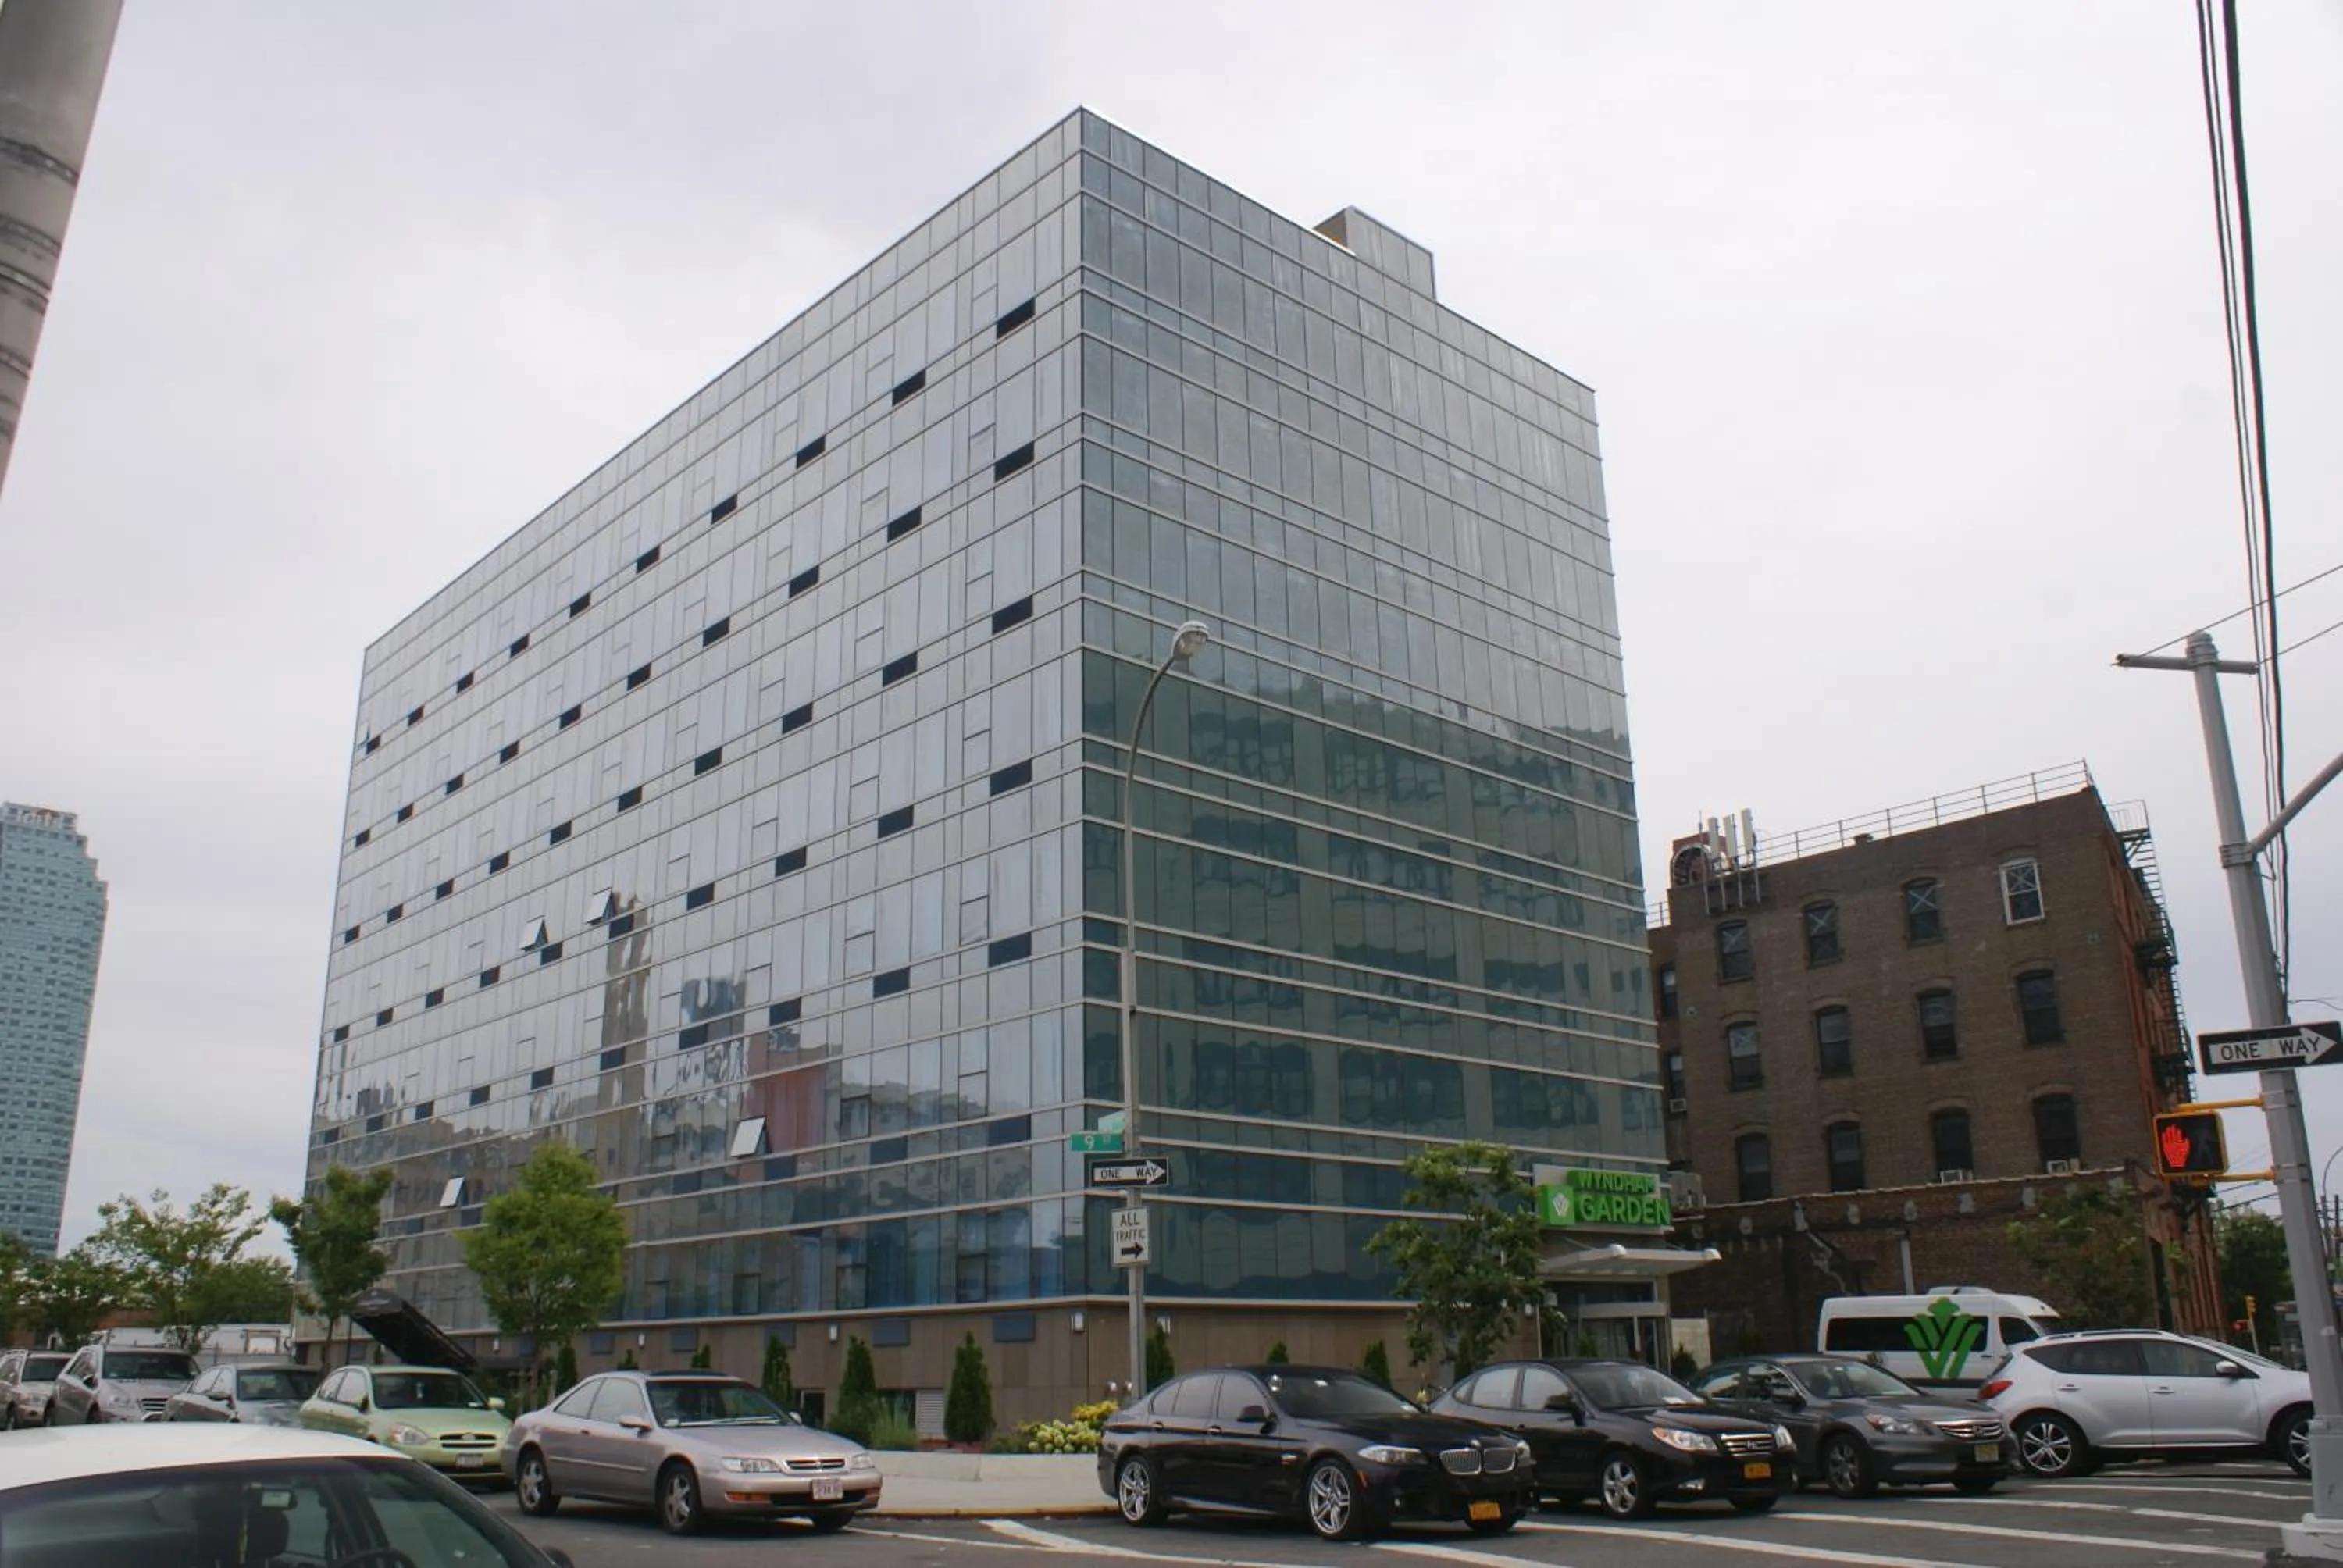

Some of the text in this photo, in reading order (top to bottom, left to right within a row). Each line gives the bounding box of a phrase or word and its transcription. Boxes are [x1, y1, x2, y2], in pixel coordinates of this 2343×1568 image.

[2220, 1036, 2320, 1060] ONE WAY
[1084, 1135, 1094, 1150] 9
[1100, 1167, 1156, 1179] ONE WAY
[1578, 1171, 1655, 1192] WYNDHAM
[1580, 1196, 1670, 1225] GARDEN
[1120, 1212, 1139, 1227] ALL
[1115, 1230, 1145, 1242] TRAFFIC
